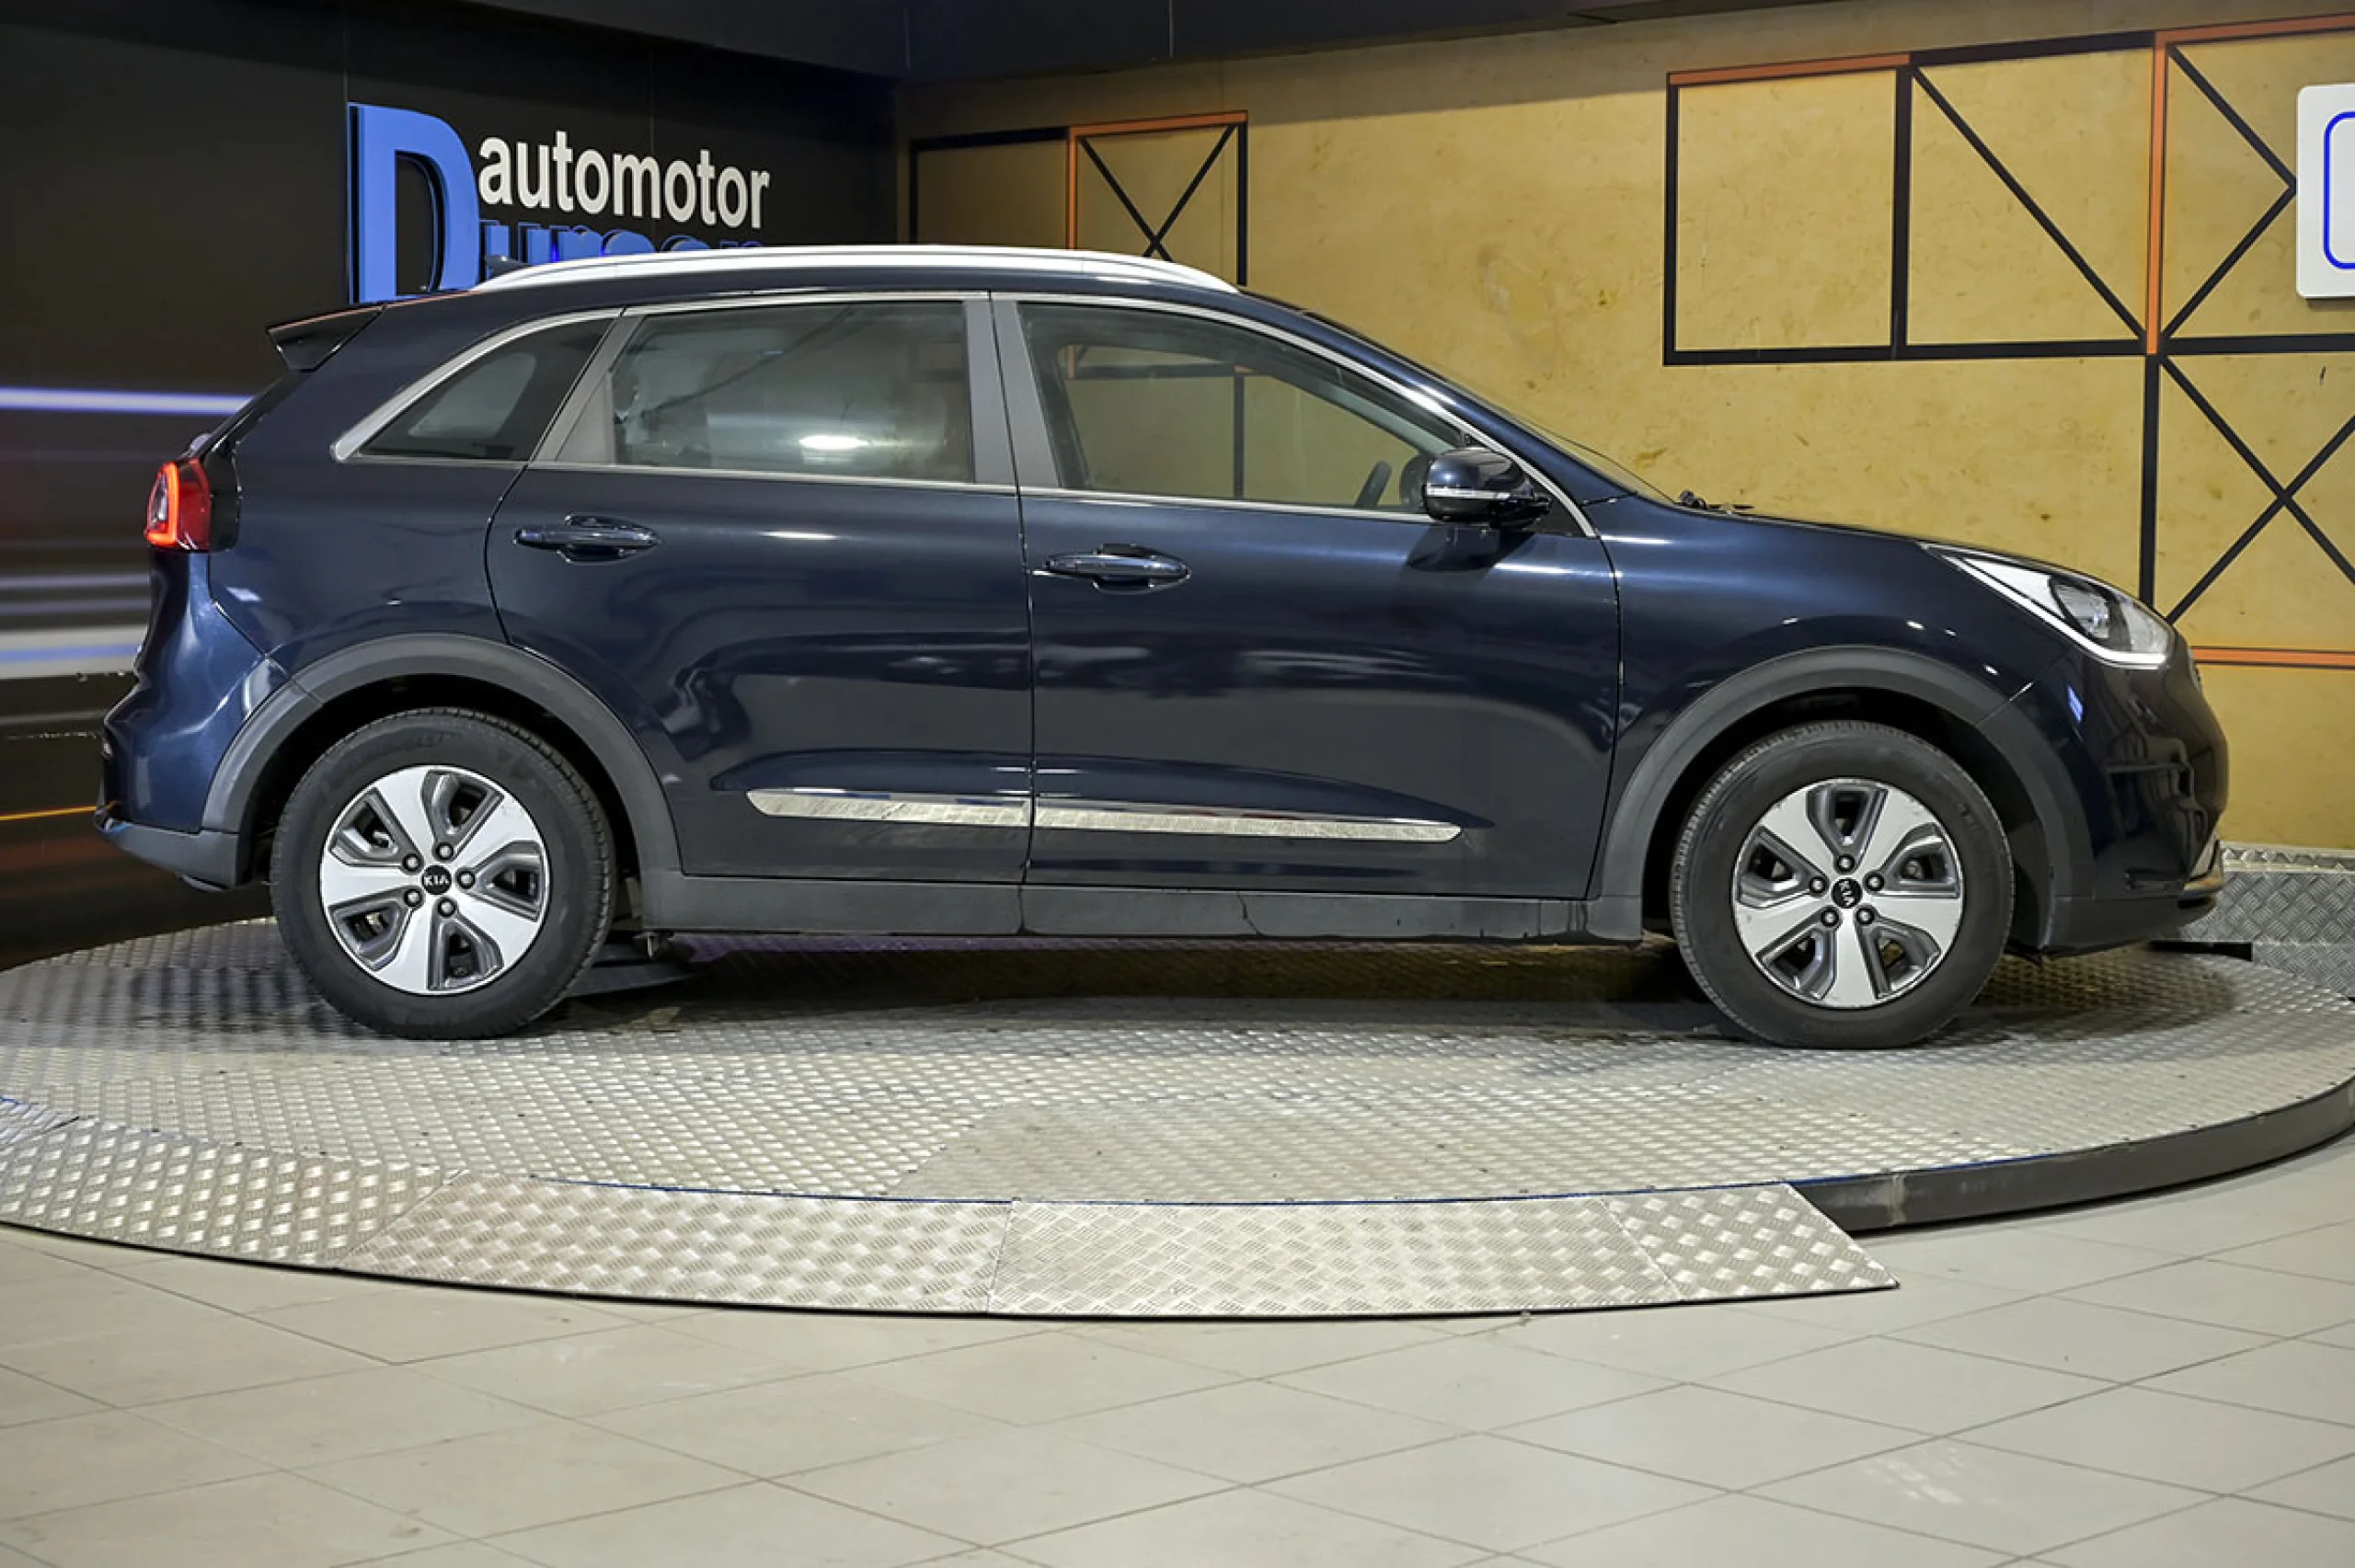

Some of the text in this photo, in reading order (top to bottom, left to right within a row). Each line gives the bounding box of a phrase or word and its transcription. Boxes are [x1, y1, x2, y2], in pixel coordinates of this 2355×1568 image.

[478, 131, 770, 229] automotor
[423, 875, 450, 886] KIA
[1839, 880, 1855, 906] KIA
